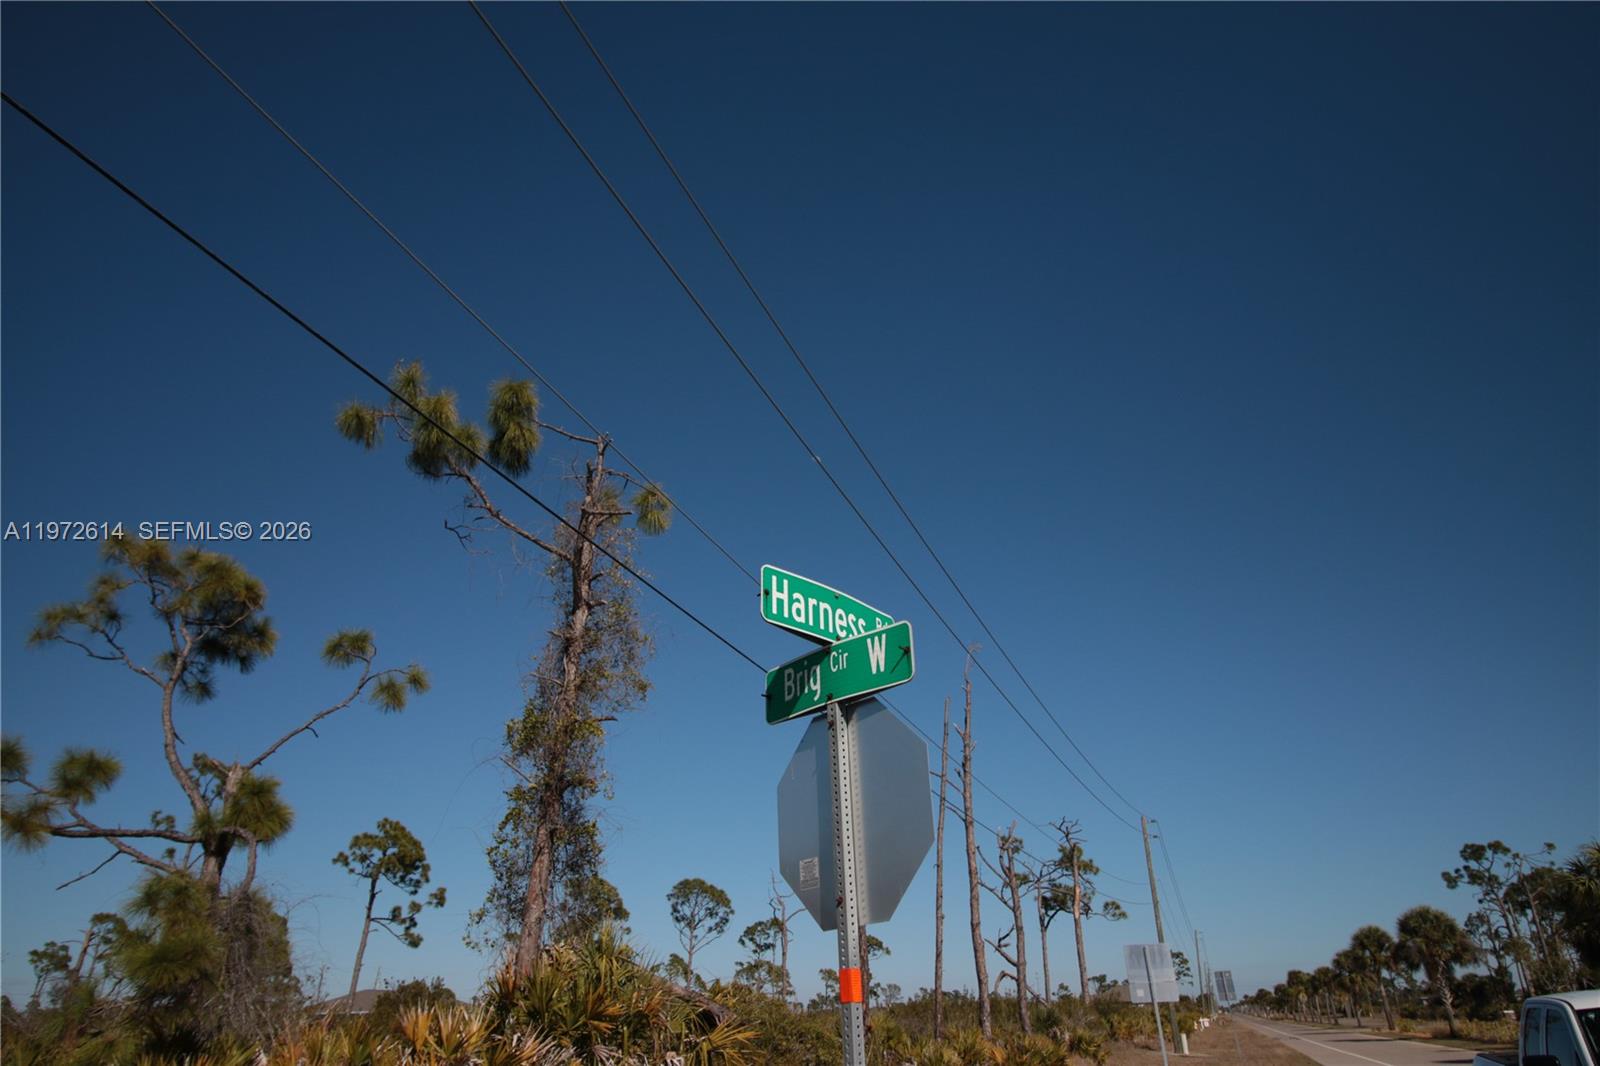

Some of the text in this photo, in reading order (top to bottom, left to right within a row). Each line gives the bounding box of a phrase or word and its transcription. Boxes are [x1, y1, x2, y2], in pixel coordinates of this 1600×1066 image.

[771, 575, 866, 637] Harness
[784, 633, 887, 701] Brig Cir W
